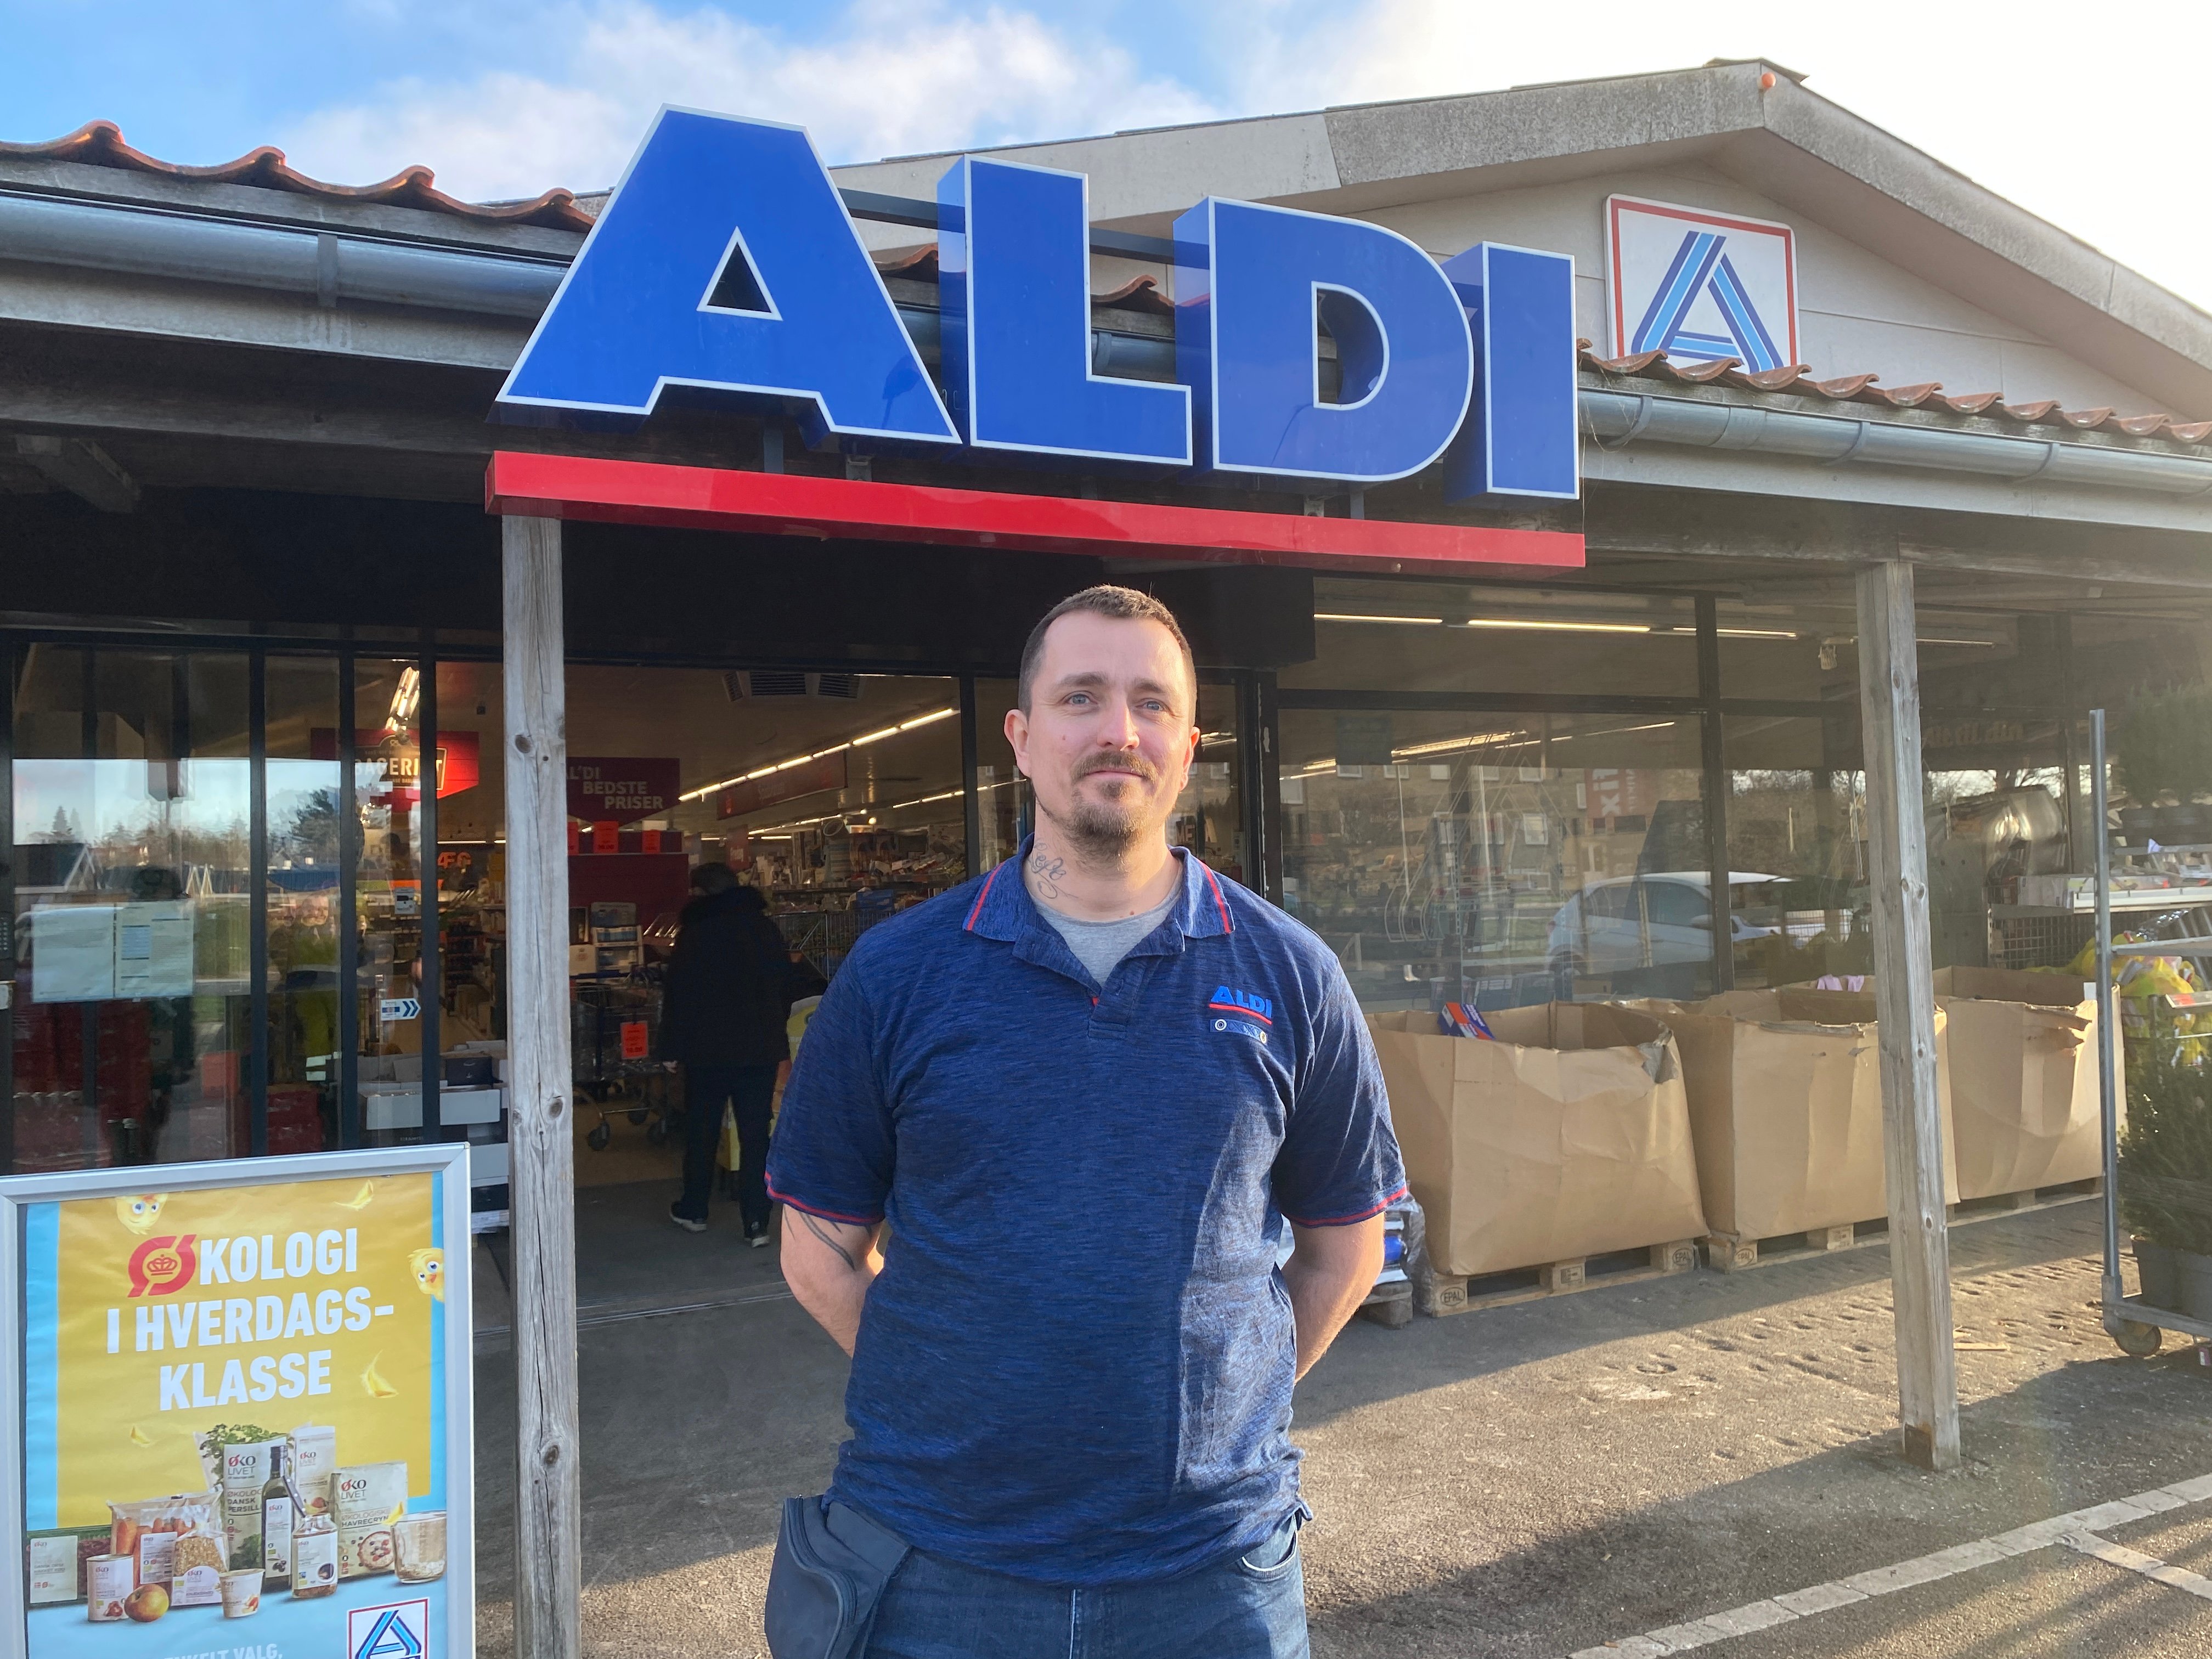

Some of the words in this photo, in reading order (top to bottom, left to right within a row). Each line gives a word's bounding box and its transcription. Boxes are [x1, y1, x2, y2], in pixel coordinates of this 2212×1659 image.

[495, 103, 1580, 500] ALDI
[583, 781, 647, 794] BEDSTE
[604, 795, 663, 809] PRISER
[1211, 985, 1272, 1018] ALDI
[127, 1228, 357, 1298] ØKOLOGI
[1444, 1290, 1462, 1303] EPAL
[106, 1308, 120, 1353] I
[136, 1286, 394, 1352] HVERDAGS-
[160, 1349, 331, 1411] KLASSE
[228, 1466, 256, 1475] LIVET
[341, 1489, 367, 1500] LIVET
